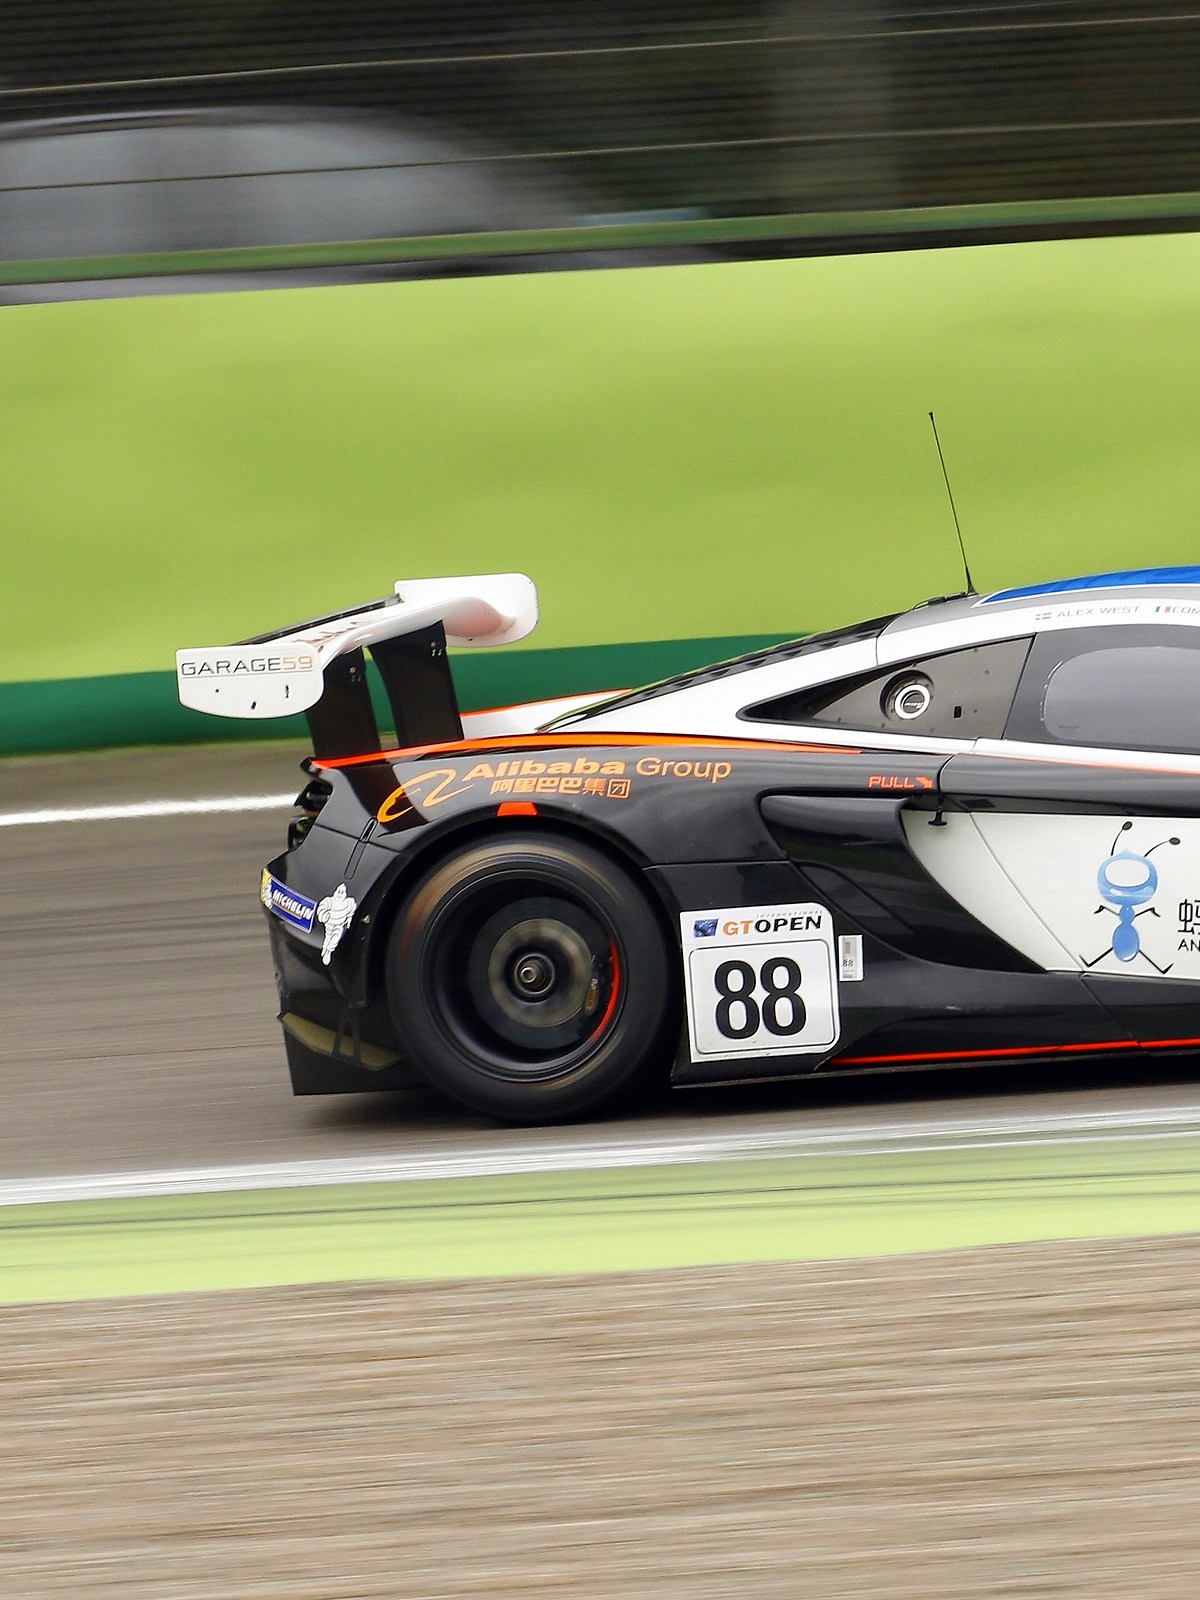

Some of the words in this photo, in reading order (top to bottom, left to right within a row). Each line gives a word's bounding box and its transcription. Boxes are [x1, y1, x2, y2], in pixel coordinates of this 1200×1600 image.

[1057, 607, 1094, 618] ALEX
[1099, 604, 1142, 615] WEST
[180, 656, 314, 677] GARAGE59
[461, 757, 627, 782] Alibaba
[636, 756, 733, 784] Group
[489, 776, 632, 799] 阿里巴巴集团
[868, 775, 916, 789] PULL
[272, 889, 315, 921] MICHELIN
[714, 956, 807, 1040] 88
